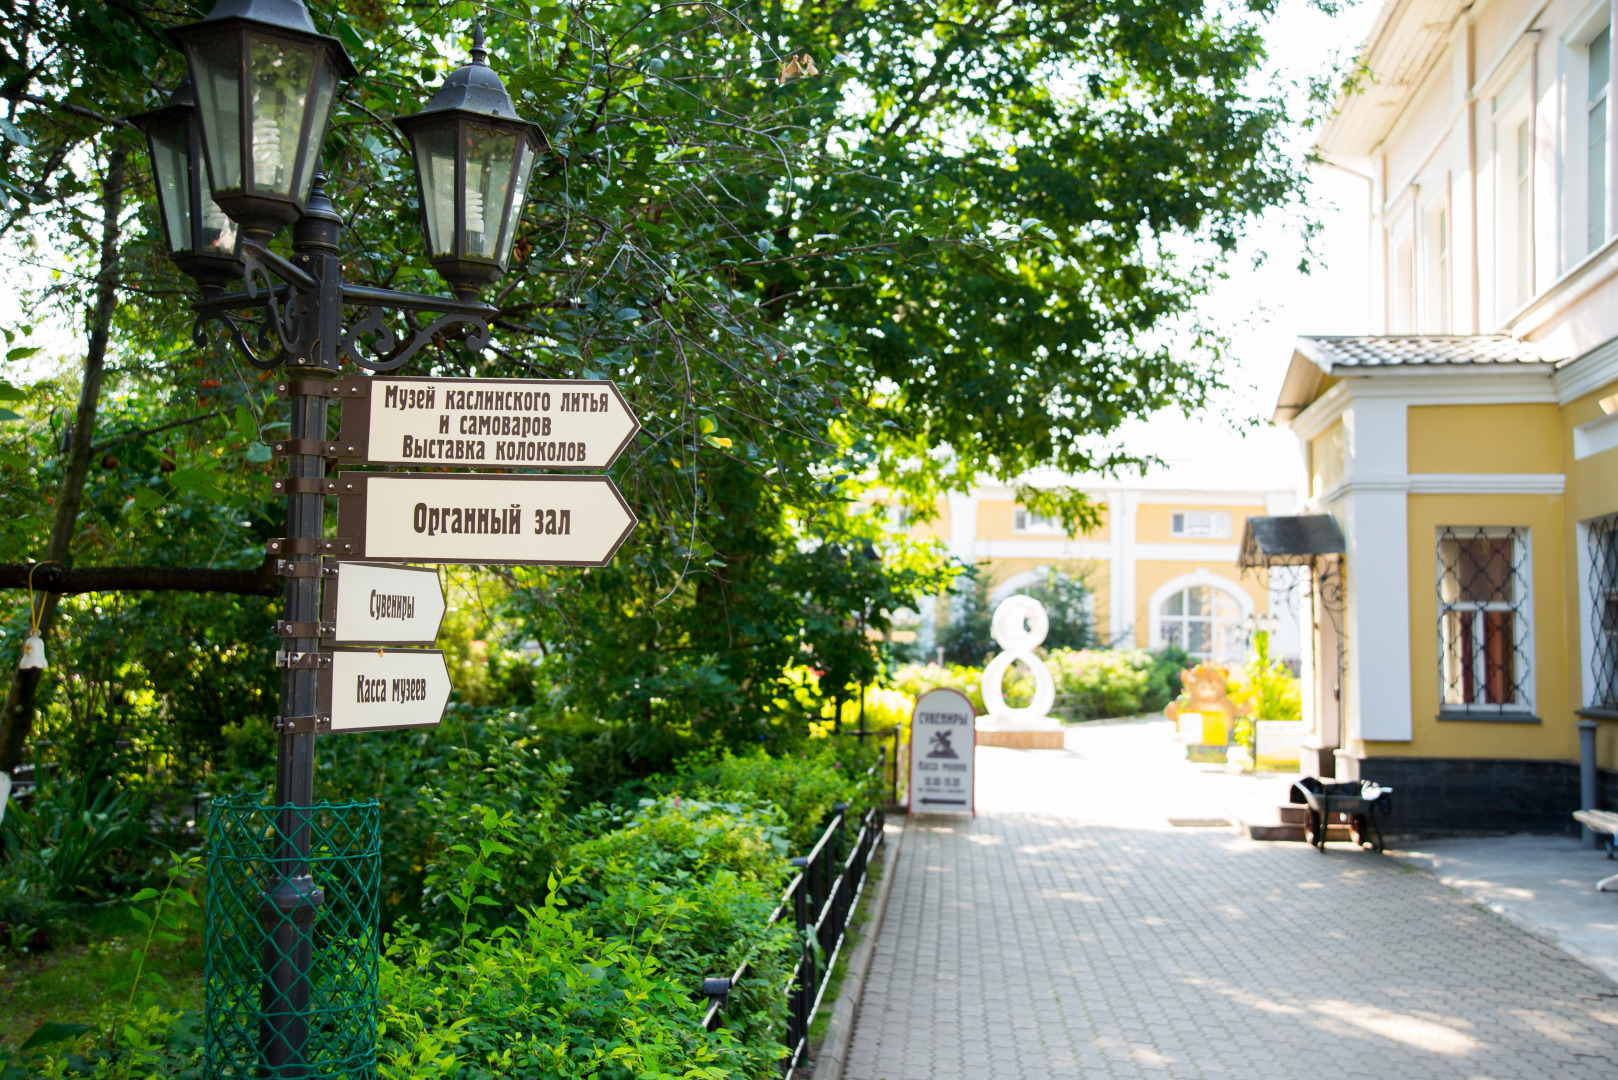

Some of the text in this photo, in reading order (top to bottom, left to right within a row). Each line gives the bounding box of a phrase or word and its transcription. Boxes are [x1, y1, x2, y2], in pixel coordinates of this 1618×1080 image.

[385, 385, 609, 413] Музей каслинского литья
[439, 414, 552, 438] и самоваров
[402, 434, 587, 462] Выставка колоколов
[413, 502, 571, 536] Органный зал
[370, 589, 415, 621] Сувениры
[357, 675, 427, 704] Касса музеев
